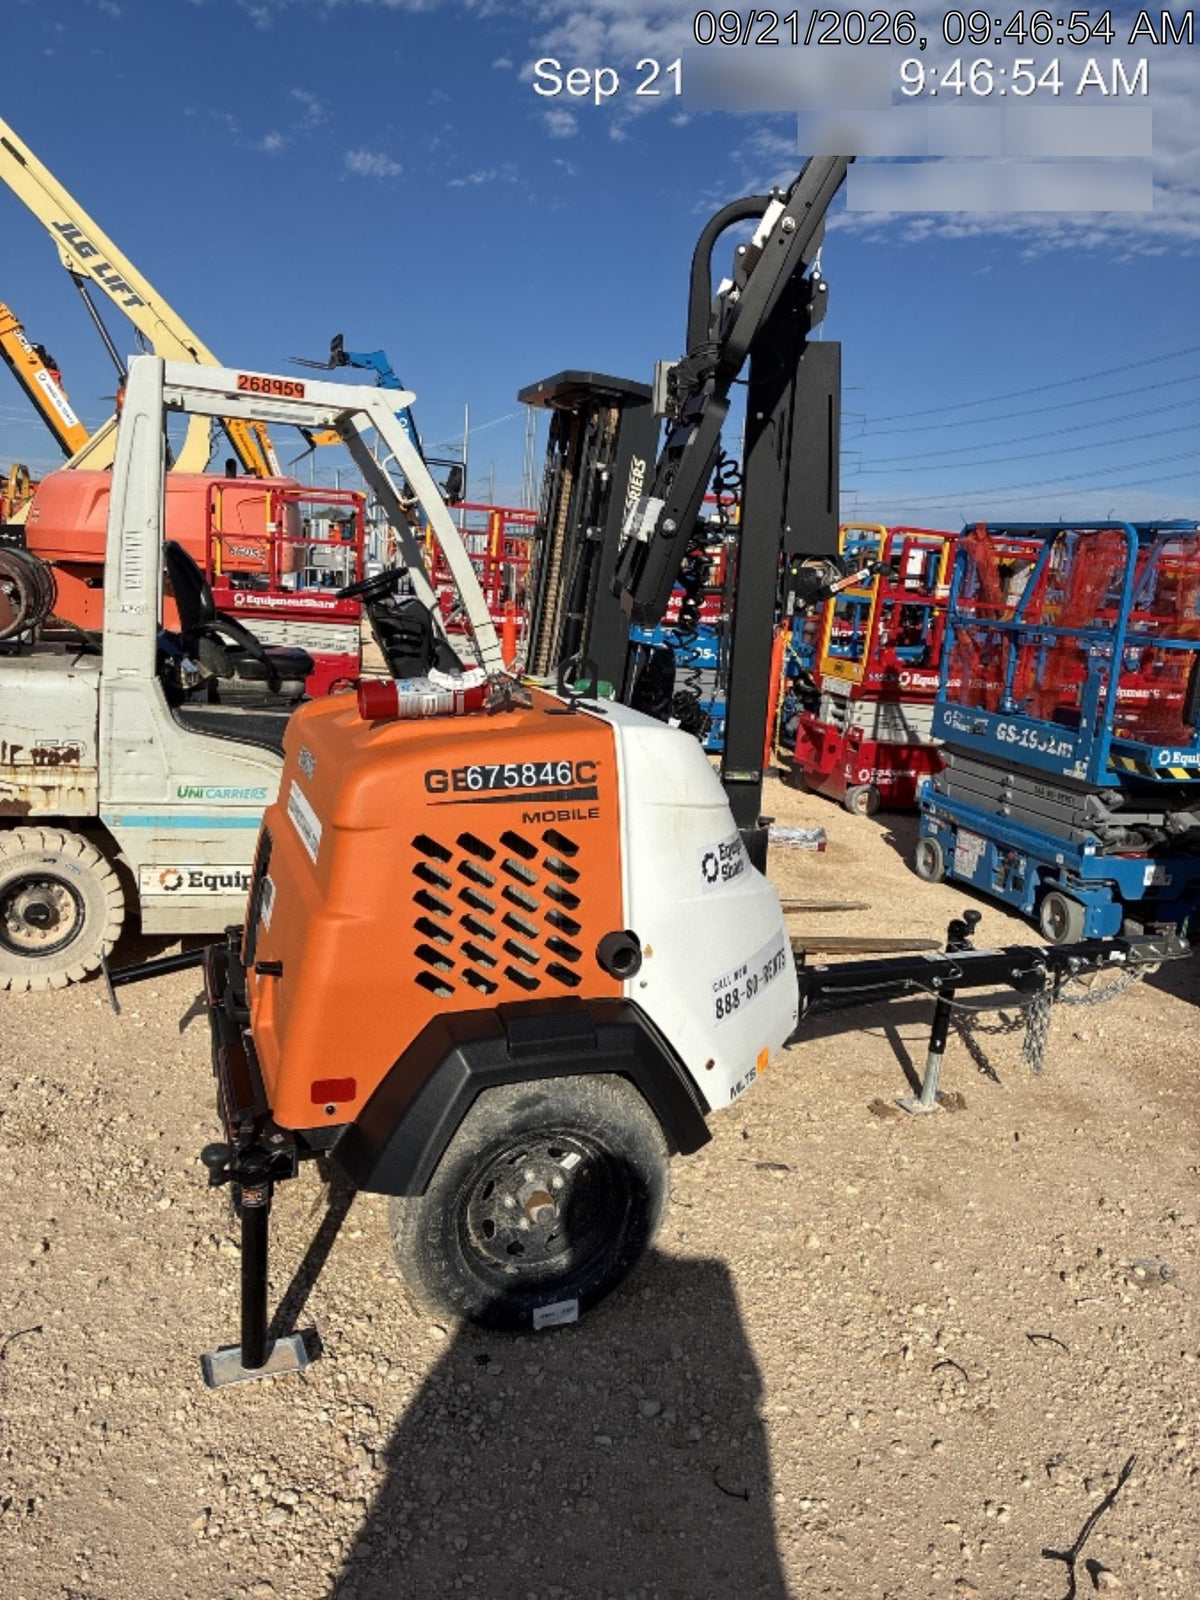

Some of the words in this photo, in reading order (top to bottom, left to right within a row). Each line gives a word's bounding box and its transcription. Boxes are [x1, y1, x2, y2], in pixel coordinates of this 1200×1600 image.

[51, 221, 99, 259] JLG
[91, 262, 145, 307] LIFT
[238, 374, 305, 399] 268959
[466, 761, 573, 791] 675846
[522, 808, 600, 824] MOBILE
